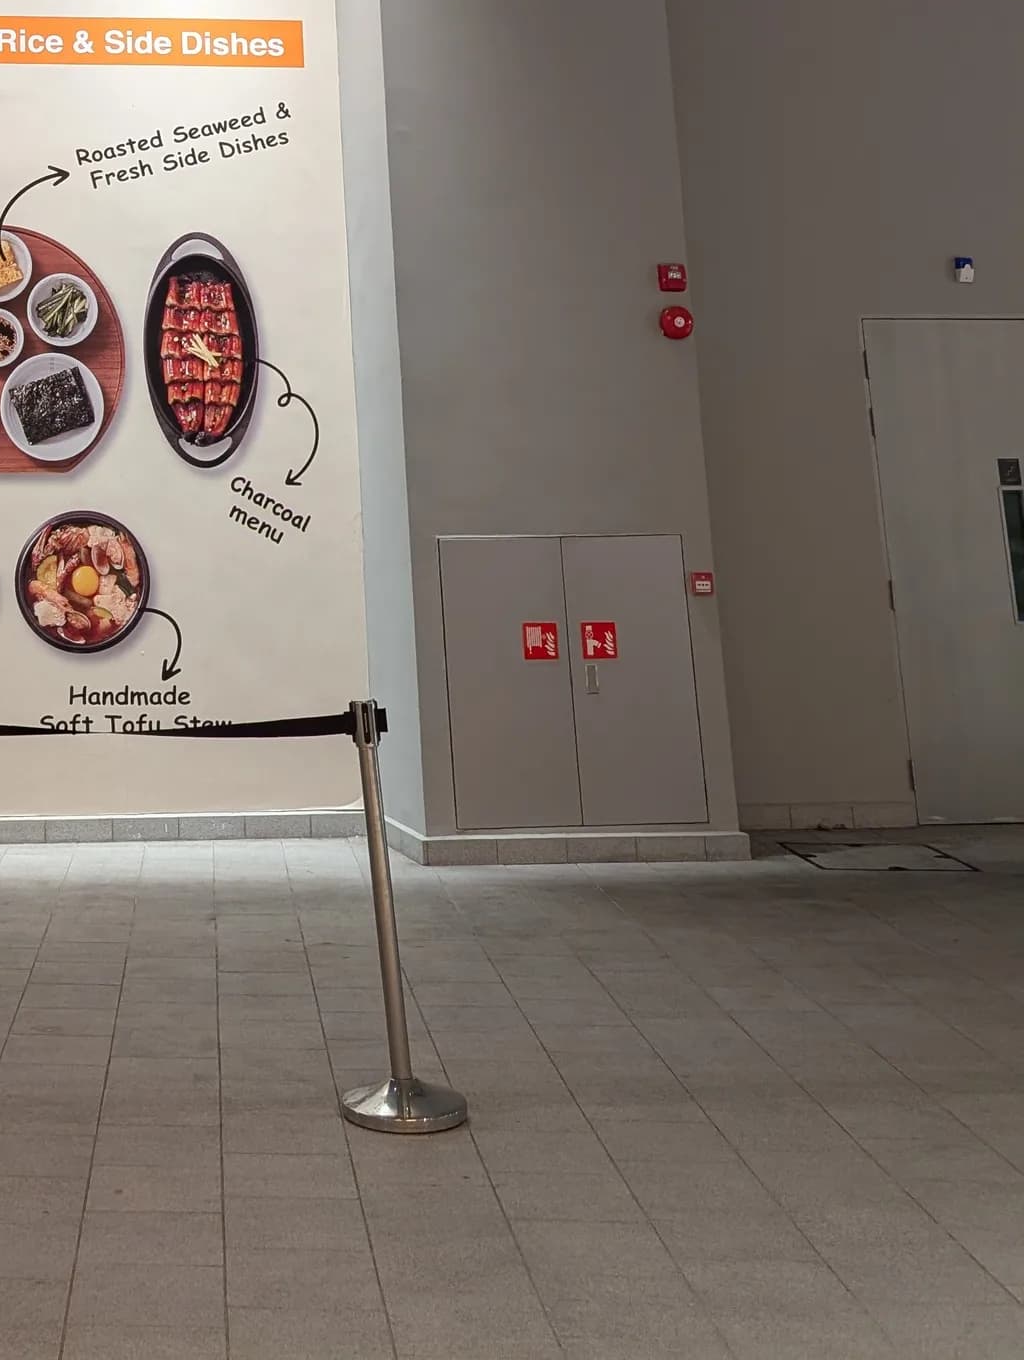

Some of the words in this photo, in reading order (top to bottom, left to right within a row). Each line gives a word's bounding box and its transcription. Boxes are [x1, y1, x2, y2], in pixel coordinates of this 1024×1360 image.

[72, 30, 95, 54] &
[104, 29, 172, 56] Side
[181, 31, 286, 57] Dishes
[75, 130, 164, 166] Roasted
[173, 106, 267, 143] Seaweed
[276, 102, 292, 120] &
[90, 159, 154, 189] Fresh
[163, 147, 210, 171] Side
[218, 131, 290, 158] Dishes
[228, 504, 285, 545] menu
[230, 476, 312, 533] Charcoal
[69, 684, 192, 707] Handmade
[39, 713, 94, 736] Soft
[104, 713, 161, 734] Tofu
